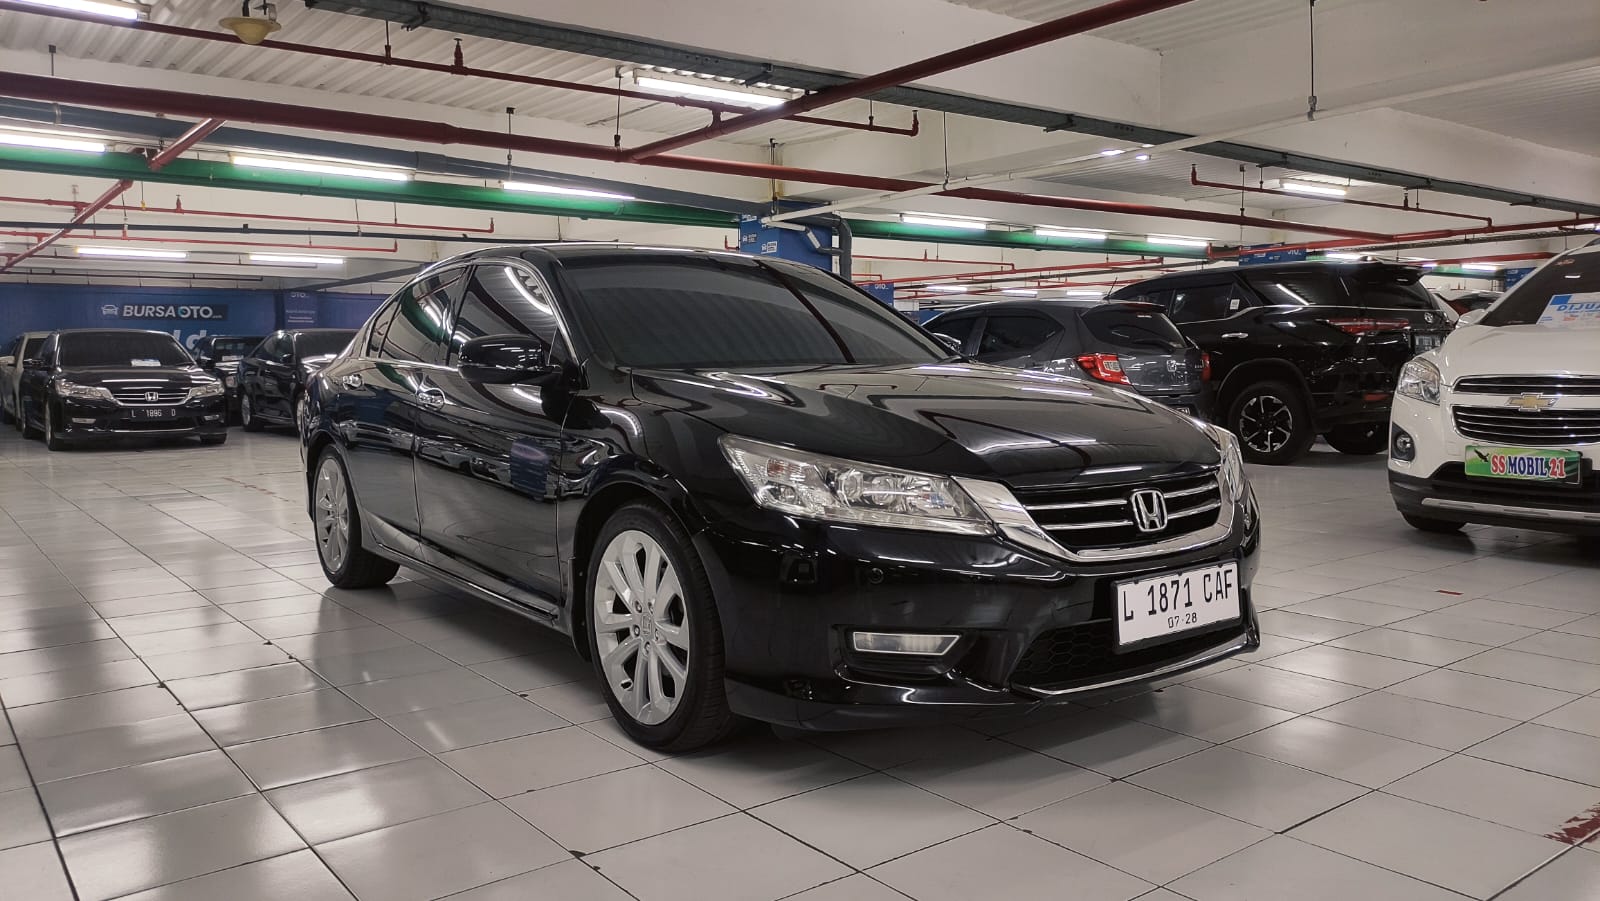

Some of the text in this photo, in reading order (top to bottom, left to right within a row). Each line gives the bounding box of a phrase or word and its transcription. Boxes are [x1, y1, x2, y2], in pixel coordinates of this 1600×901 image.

[131, 409, 137, 418] L
[1491, 454, 1566, 479] SS MOBIL 21
[1123, 569, 1233, 622] L 1871 CAF
